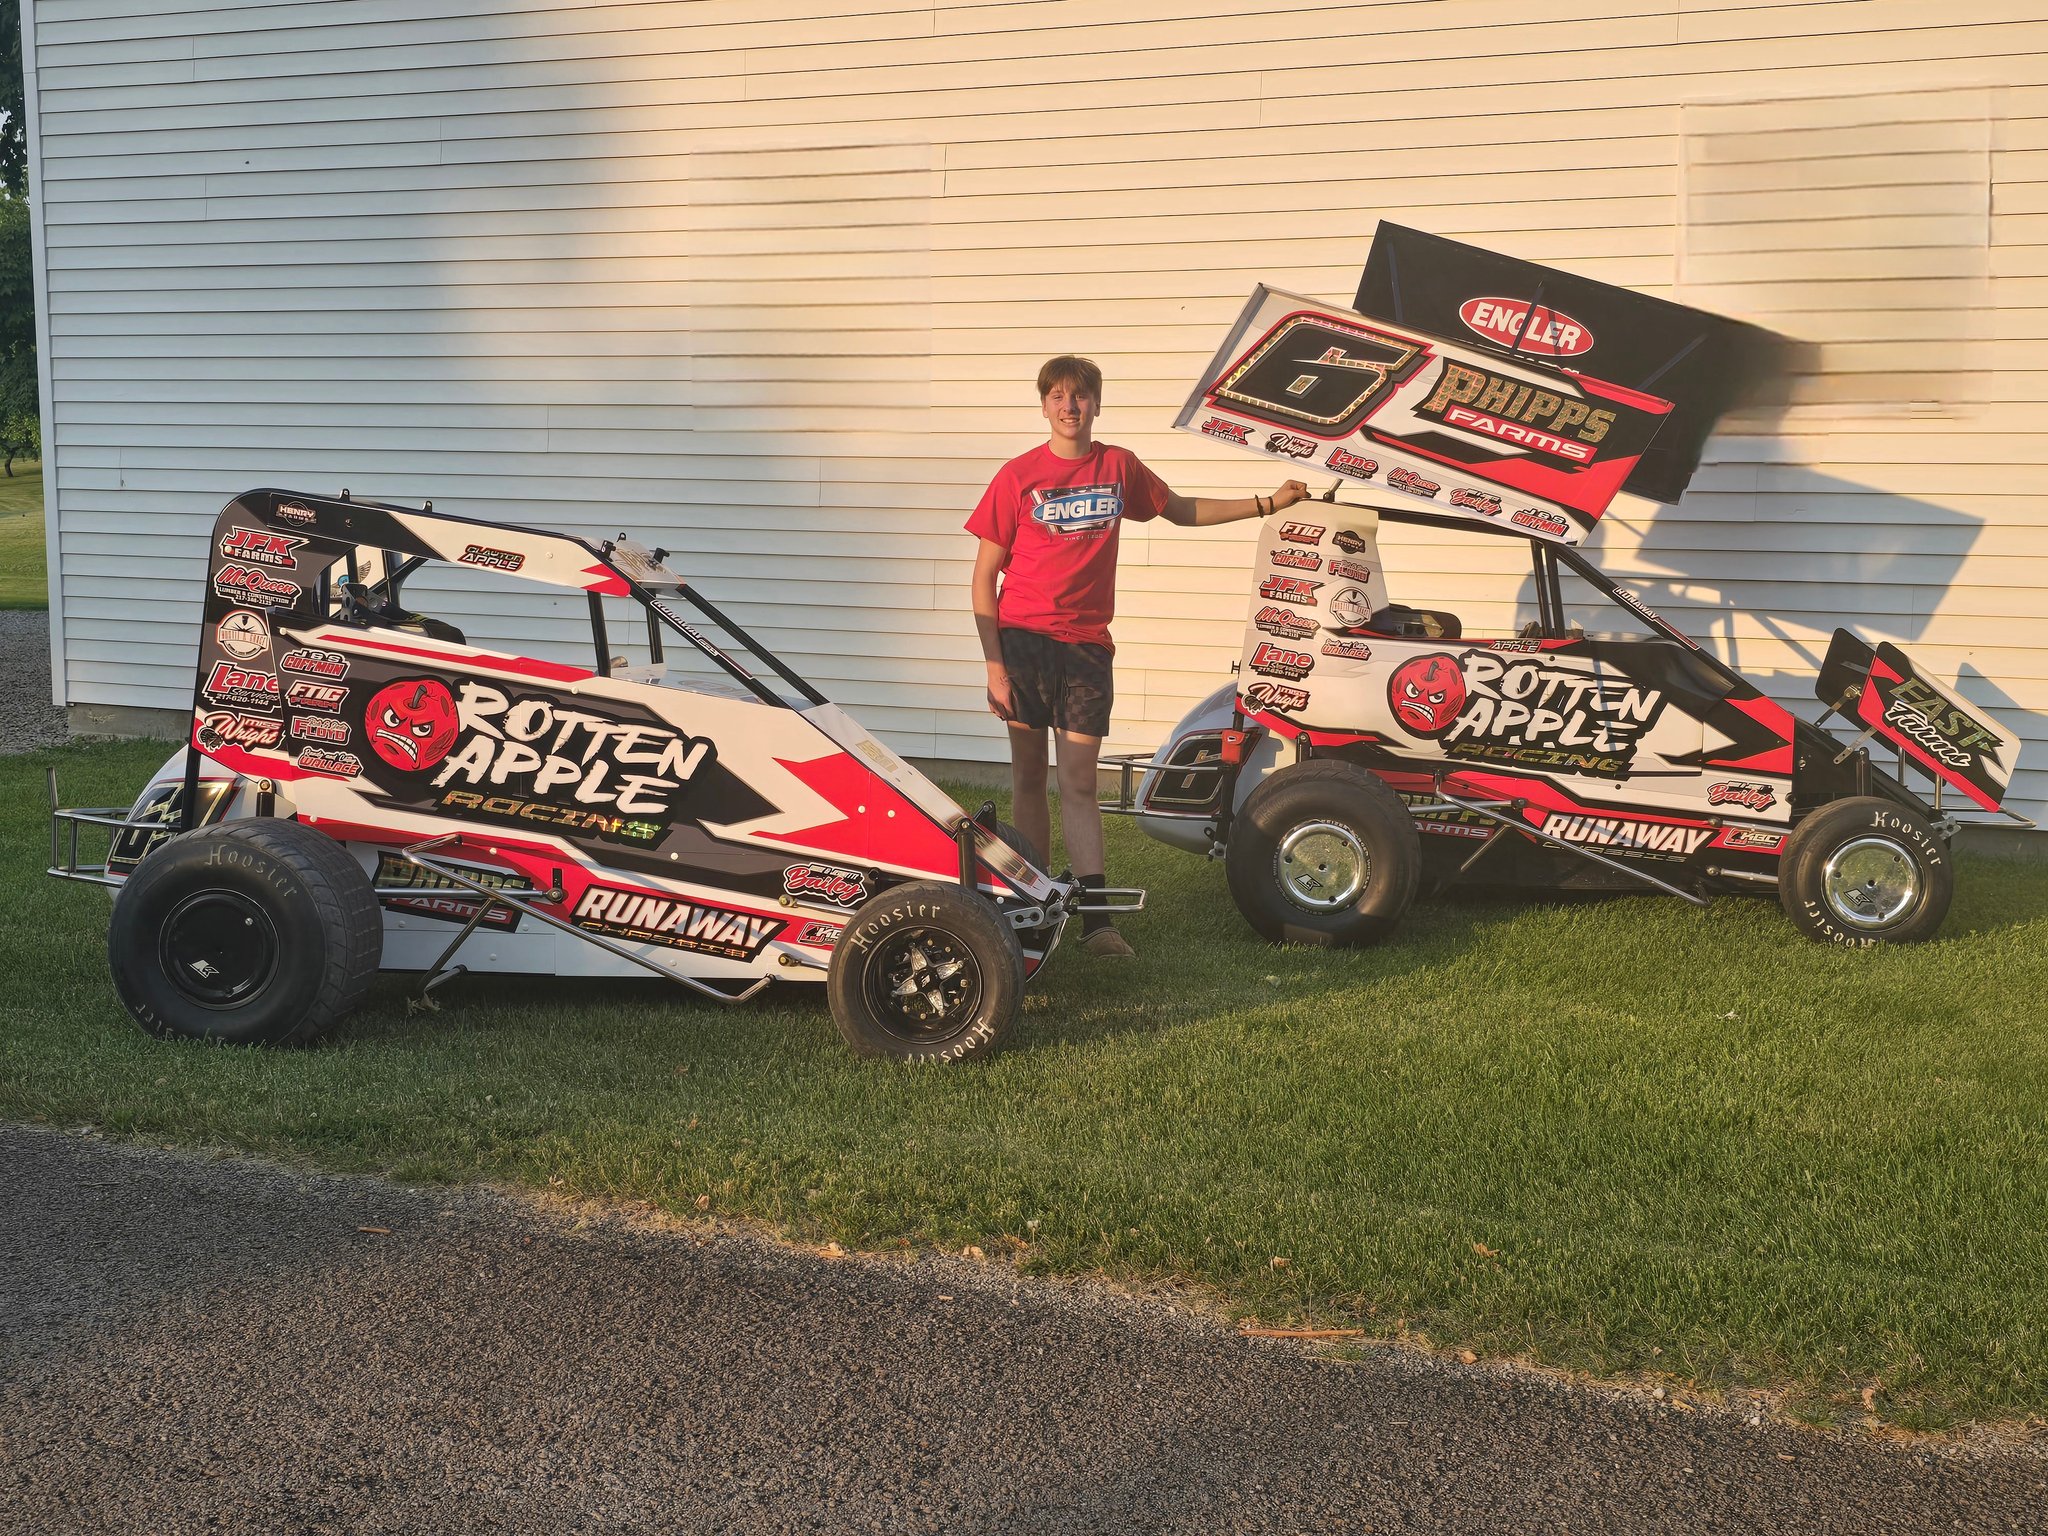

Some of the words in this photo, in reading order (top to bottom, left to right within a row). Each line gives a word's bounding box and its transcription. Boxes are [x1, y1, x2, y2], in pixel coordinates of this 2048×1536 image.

[1471, 301, 1582, 350] ENGLER
[1423, 363, 1617, 443] PHIPPS
[1203, 418, 1248, 438] JFK
[1449, 409, 1589, 459] FARMS
[1271, 432, 1312, 455] Wright
[1327, 448, 1377, 471] Lane
[1388, 468, 1438, 491] McQueen
[280, 505, 314, 518] HENRY
[1042, 497, 1119, 521] ENGLER
[1451, 489, 1500, 516] Bailey
[1512, 512, 1567, 536] COFFMAN
[224, 530, 298, 556] JFK
[234, 547, 283, 565] FARMS
[462, 553, 522, 570] APPLE
[1273, 553, 1319, 570] COFFMAN
[217, 566, 298, 595] McQueen
[1261, 575, 1315, 597] JFK
[1269, 591, 1308, 603] FARMS
[1614, 586, 1659, 620] RUNAWAY
[1255, 606, 1319, 631] McQueen
[1251, 643, 1312, 668] Lane
[1321, 645, 1372, 660] WALLACE
[1490, 643, 1539, 653] APPLE
[208, 663, 280, 694] Lane
[284, 655, 345, 676] COFFMAN
[1248, 684, 1307, 709] Wright
[1465, 654, 1662, 722] ROTTEN
[1888, 677, 1999, 747] EAST
[205, 714, 279, 747] Wright
[293, 718, 347, 741] FLOYD
[459, 681, 709, 780] ROTTEN
[1445, 700, 1637, 752] APPLE
[1885, 700, 1971, 767] Farms
[298, 756, 361, 775] WALLACE
[1452, 743, 1624, 772] RACING
[430, 734, 680, 814] APPLE
[1709, 784, 1774, 810] Bailey
[441, 790, 662, 840] RACING
[1415, 821, 1489, 838] ARMS
[1541, 813, 1714, 855] RUNAWAY
[1868, 810, 1942, 866] Hoosier
[205, 843, 299, 898] Hoosier
[786, 866, 864, 901] Bailey
[575, 887, 781, 950] RUNAWAY
[849, 900, 941, 954] Hoosier
